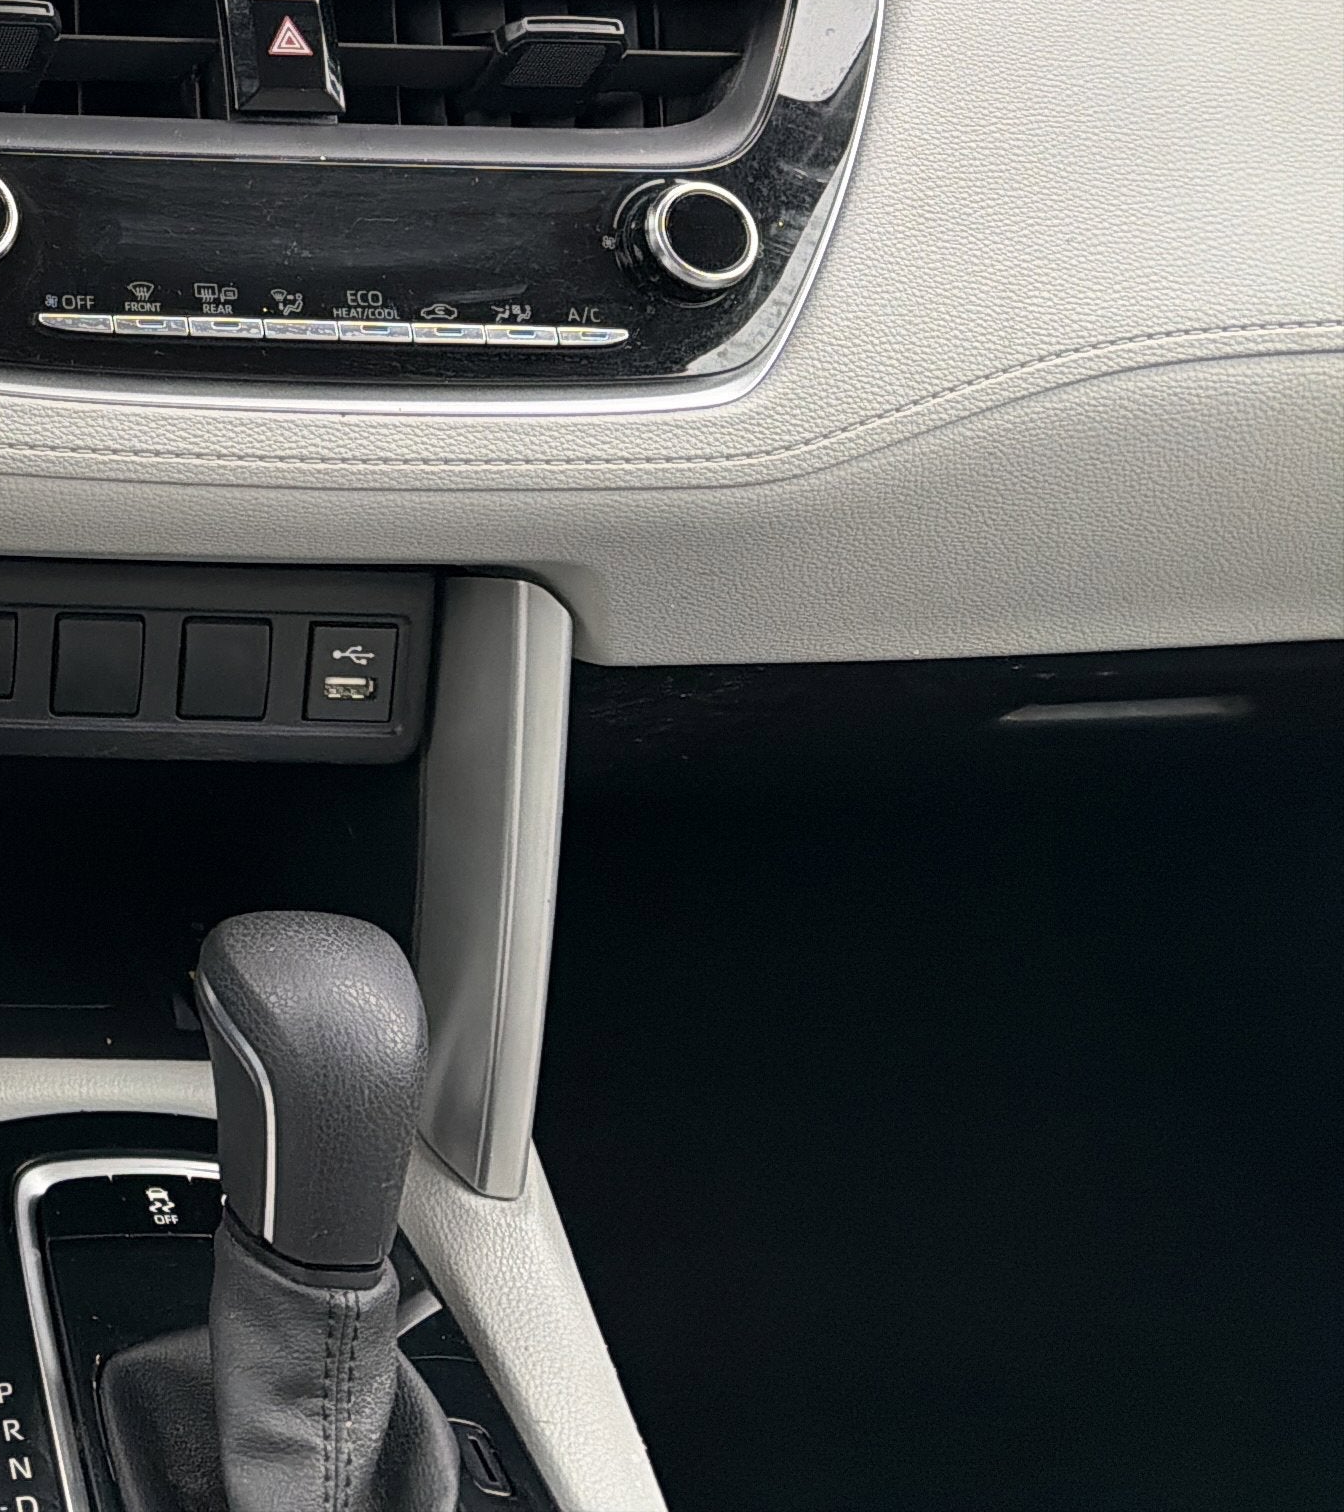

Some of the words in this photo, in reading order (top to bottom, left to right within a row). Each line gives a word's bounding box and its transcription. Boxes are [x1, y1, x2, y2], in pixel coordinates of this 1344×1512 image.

[62, 295, 95, 310] OFF
[346, 290, 383, 307] ECO
[125, 301, 161, 313] FRONT
[202, 303, 234, 315] REAR
[333, 307, 401, 320] HEAT/COOL
[567, 306, 602, 323] A/C
[153, 1214, 179, 1225] OFF
[2, 1419, 25, 1442] R
[8, 1456, 33, 1480] N
